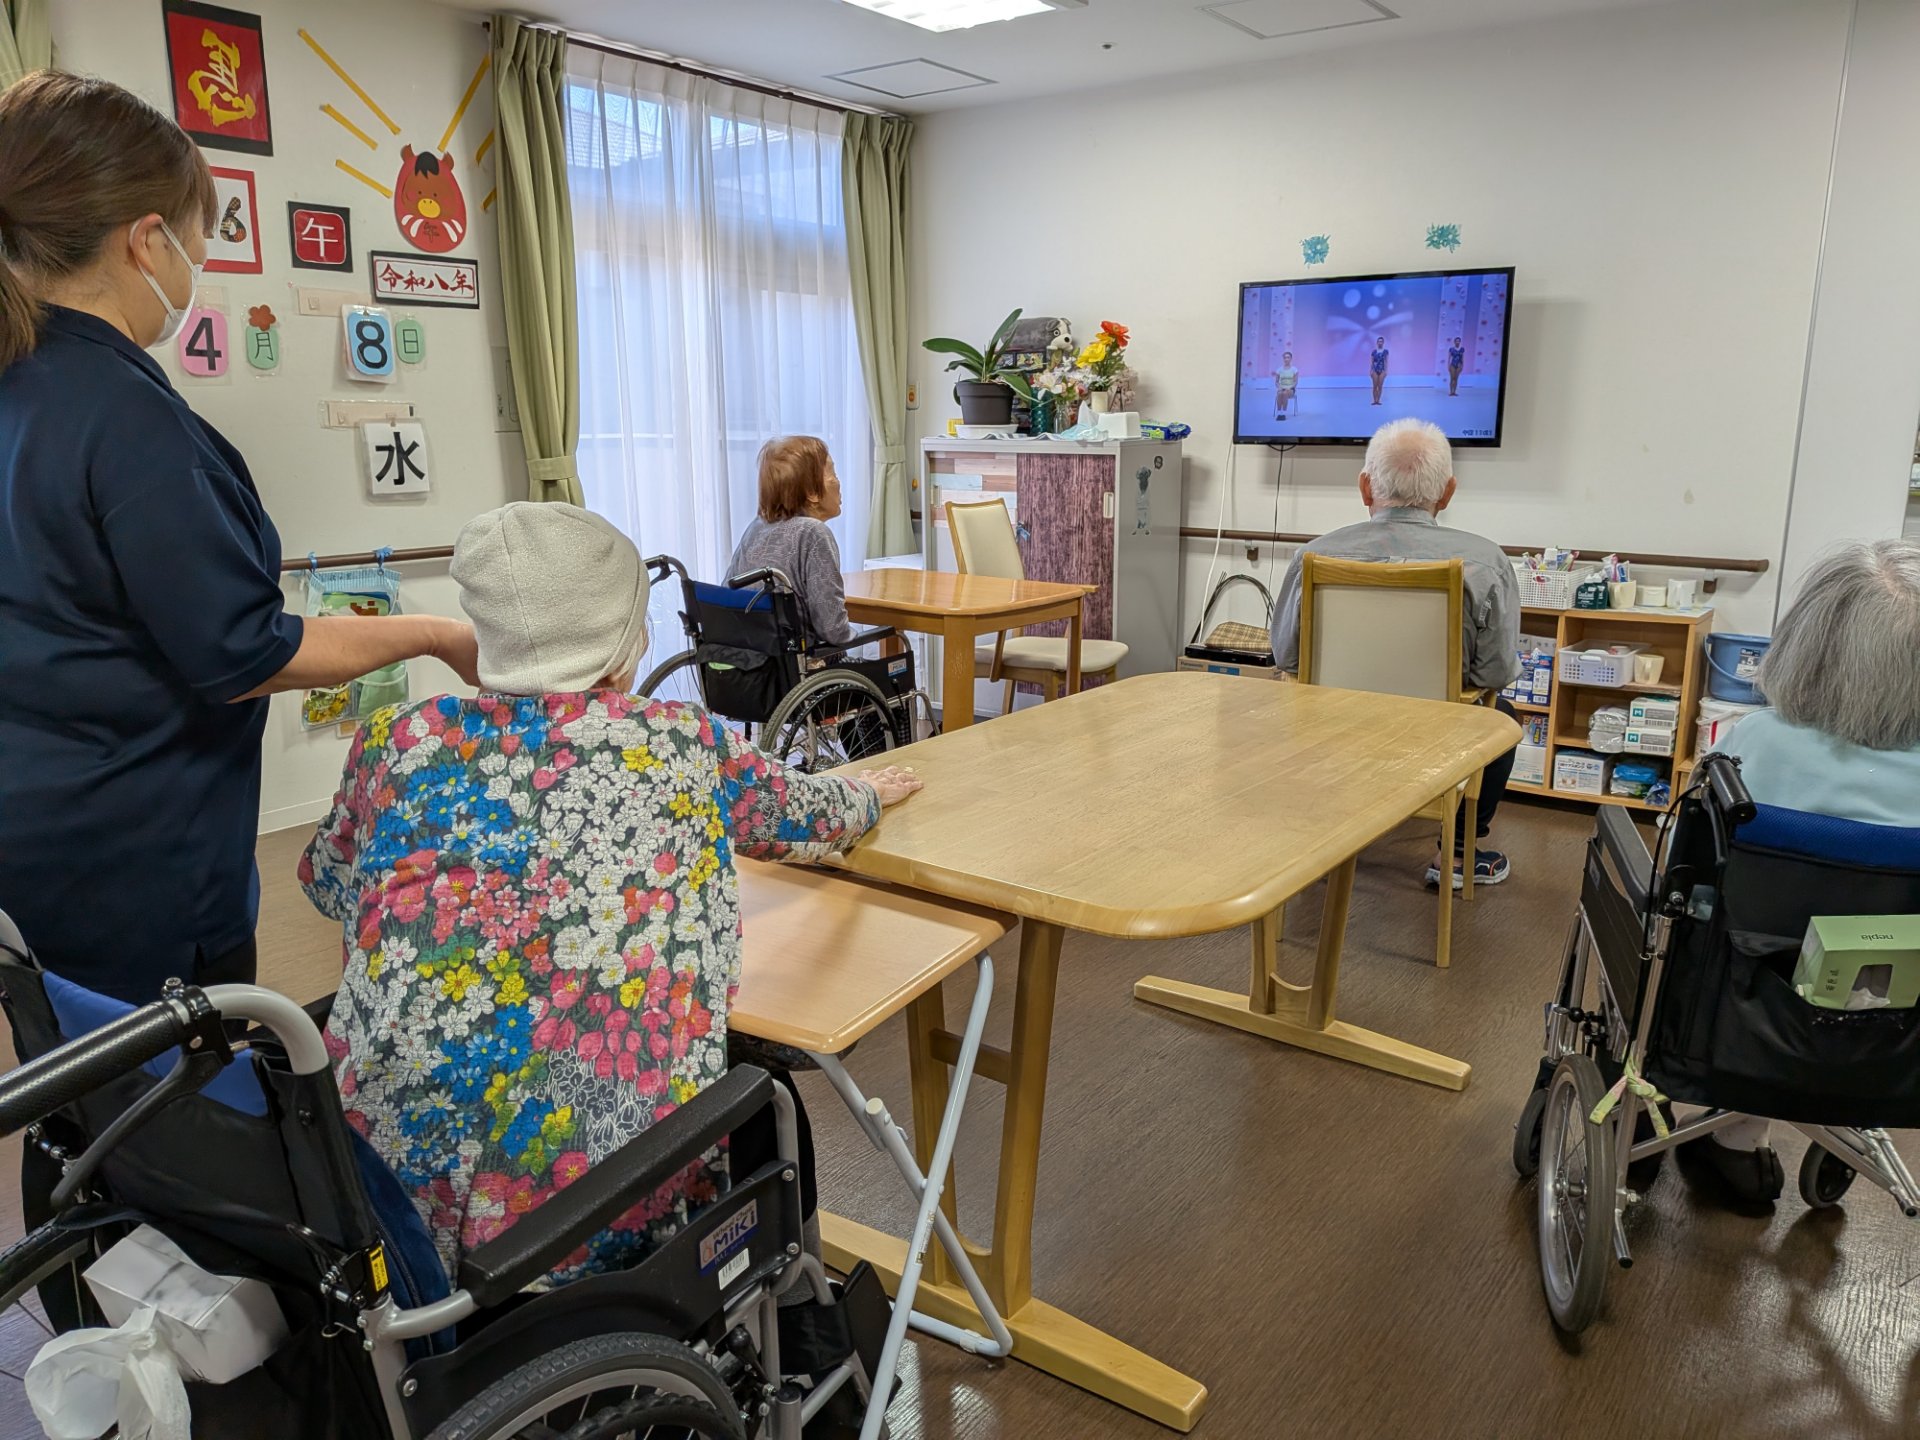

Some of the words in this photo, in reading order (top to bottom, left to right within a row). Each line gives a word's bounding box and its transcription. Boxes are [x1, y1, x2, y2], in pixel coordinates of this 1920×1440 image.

[302, 217, 339, 257] 午
[379, 263, 474, 294] 令和八年
[185, 317, 222, 371] 4
[254, 332, 274, 361] 月
[355, 320, 388, 369] 8
[402, 328, 419, 354] 日
[375, 431, 425, 485] 水
[1861, 933, 1894, 942] nepla
